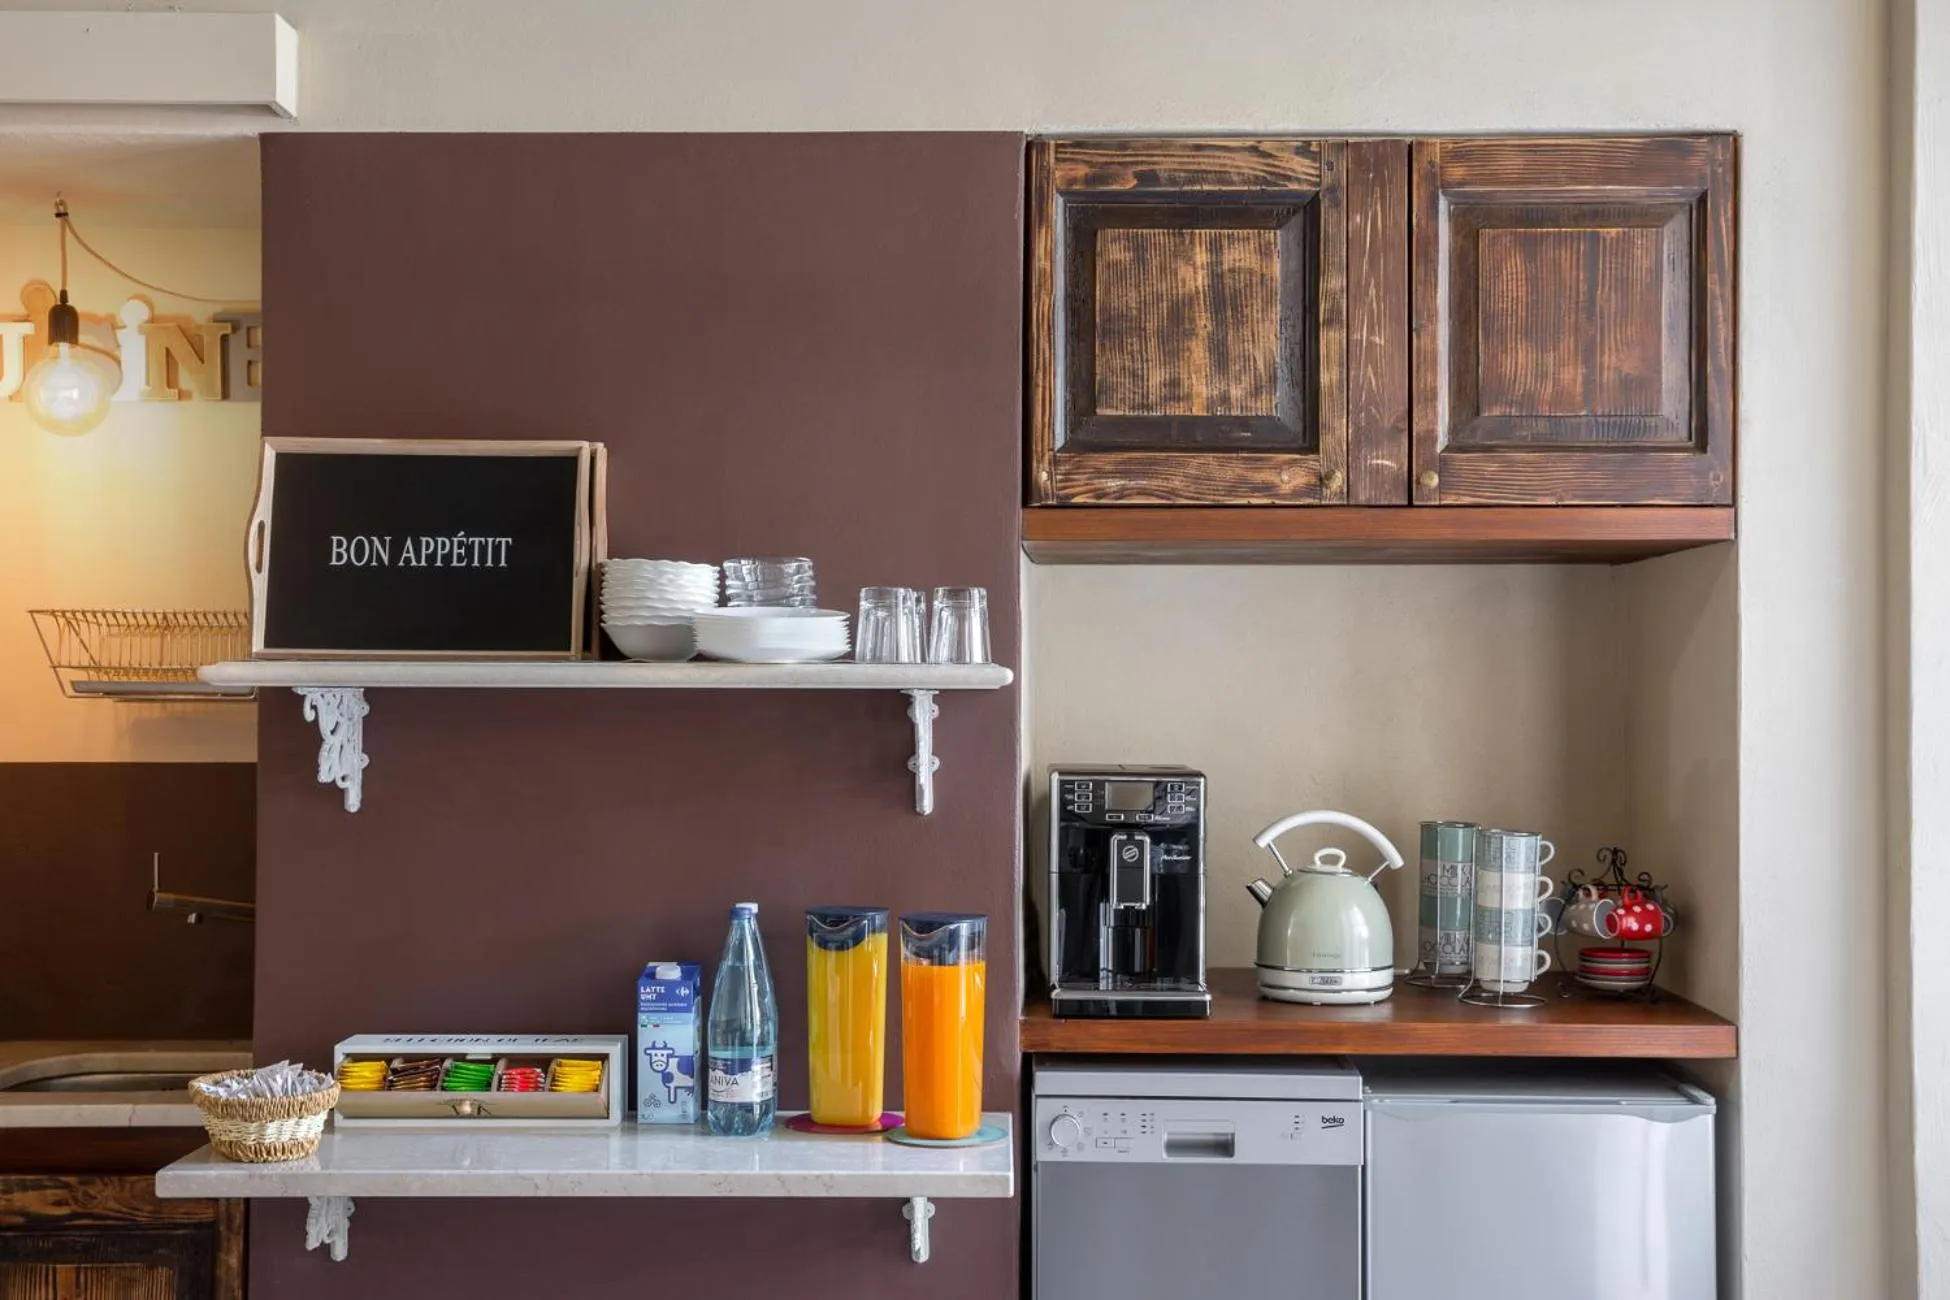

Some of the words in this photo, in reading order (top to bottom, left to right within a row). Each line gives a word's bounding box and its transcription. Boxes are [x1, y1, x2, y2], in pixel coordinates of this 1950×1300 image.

[329, 535, 392, 566] BON
[398, 530, 512, 567] APPÉTIT
[1321, 1115, 1345, 1124] beko
